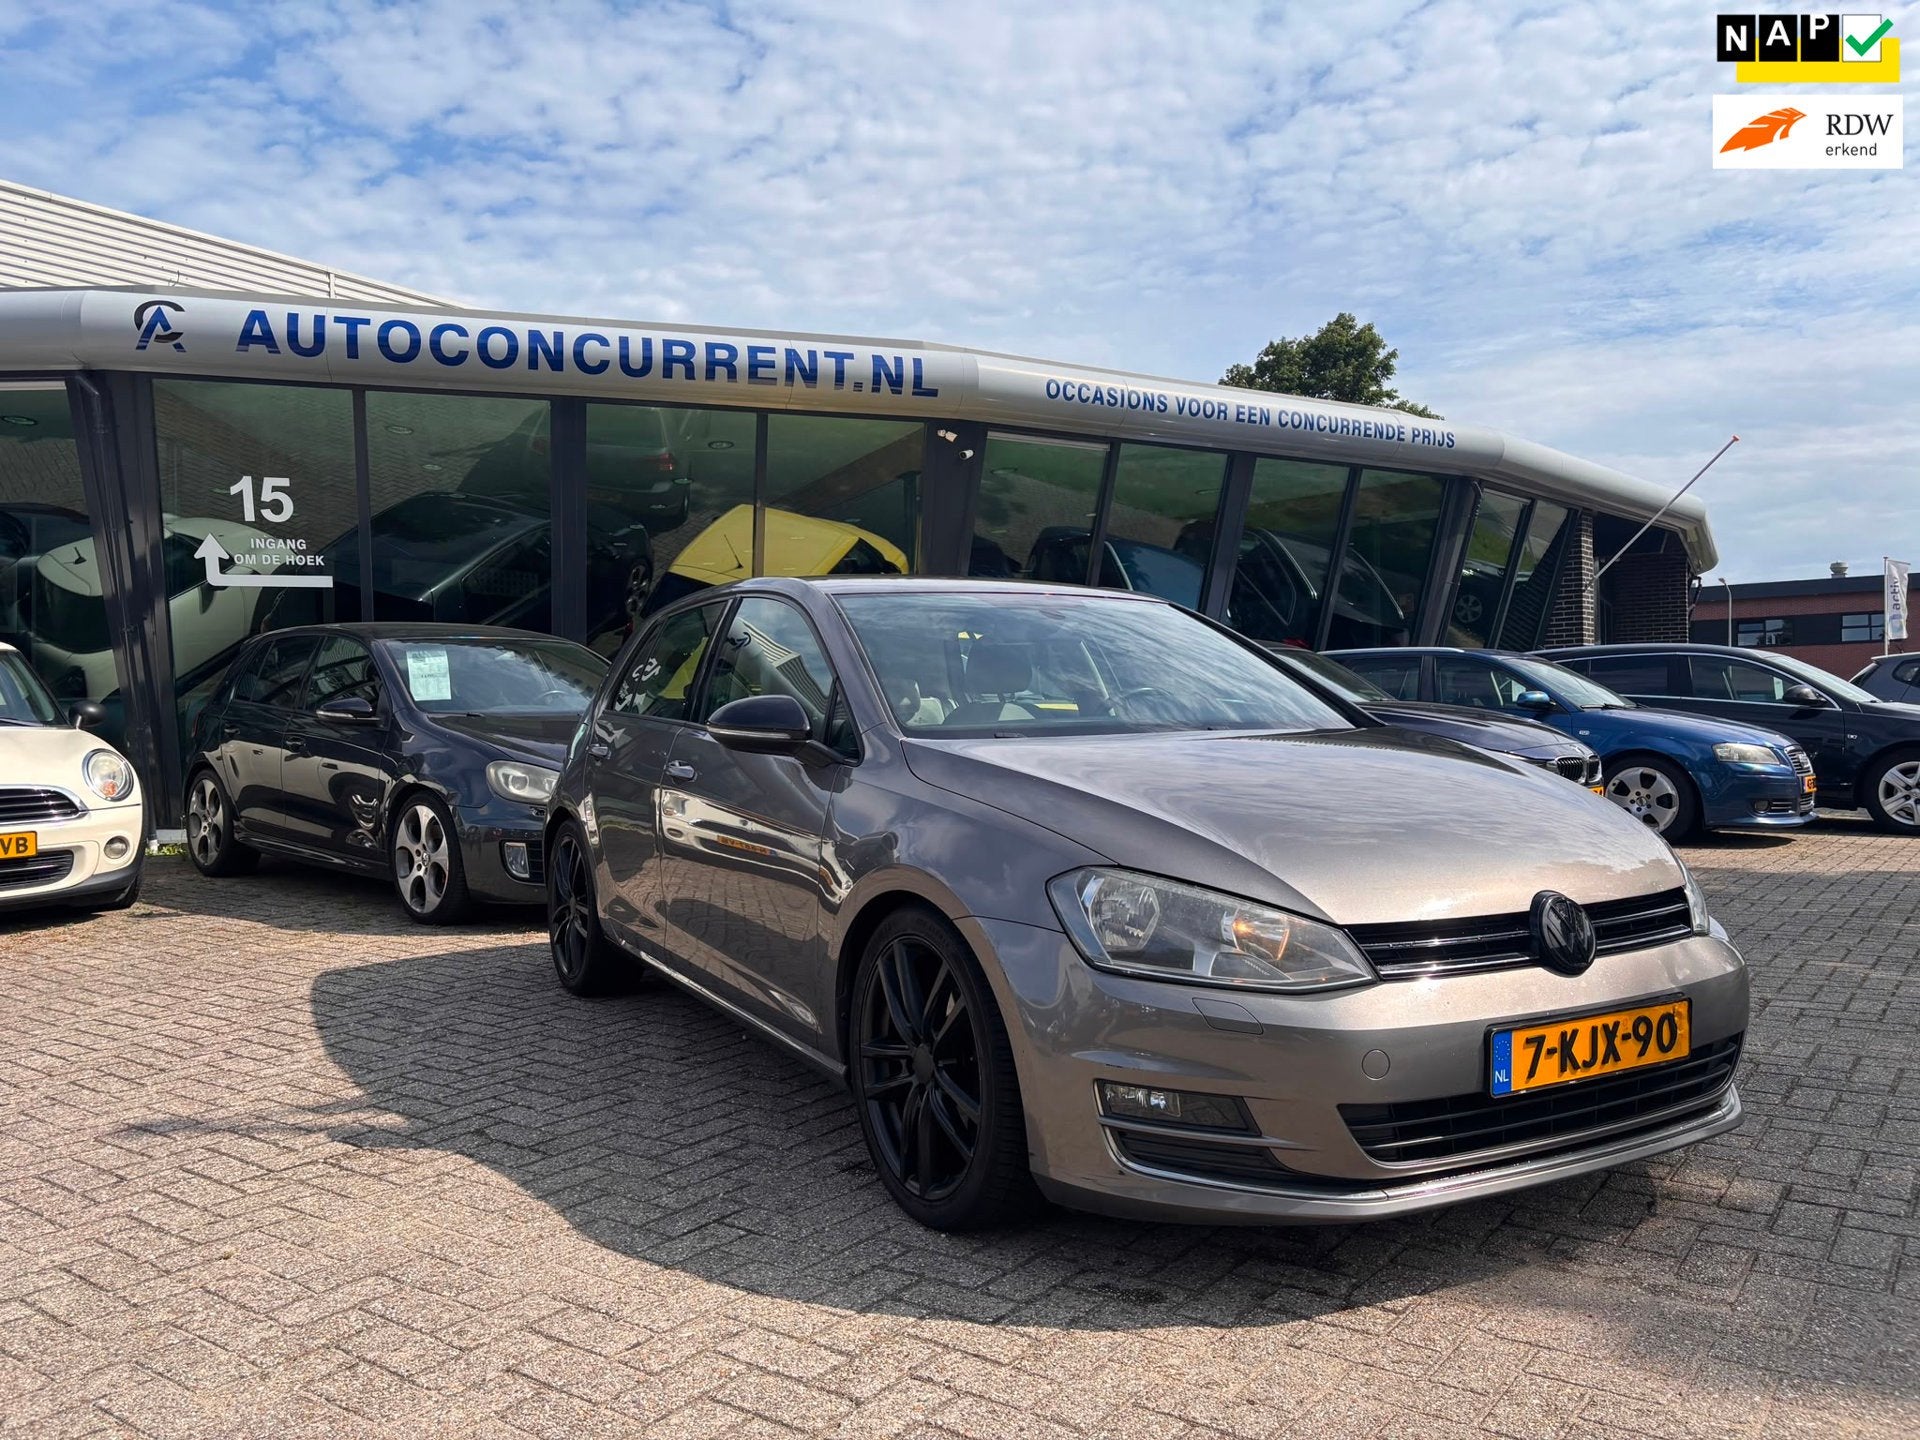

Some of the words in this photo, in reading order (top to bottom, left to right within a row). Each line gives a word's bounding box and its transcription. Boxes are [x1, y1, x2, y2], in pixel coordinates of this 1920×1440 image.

[235, 309, 939, 398] AUTOCONCURRENT.NL
[1046, 378, 1168, 413] OCCASIONS
[1174, 396, 1228, 421] VOOR
[1235, 404, 1271, 426] EEN
[1278, 409, 1406, 442] CONCURRENDE
[1411, 427, 1456, 449] PRIJS
[230, 475, 294, 523] 15
[234, 553, 257, 565] OM
[262, 554, 281, 565] DE
[286, 555, 325, 566] HOEK
[250, 538, 307, 550] INGANG
[1523, 1011, 1679, 1081] 7-KJX-90
[1494, 1069, 1510, 1084] NL
